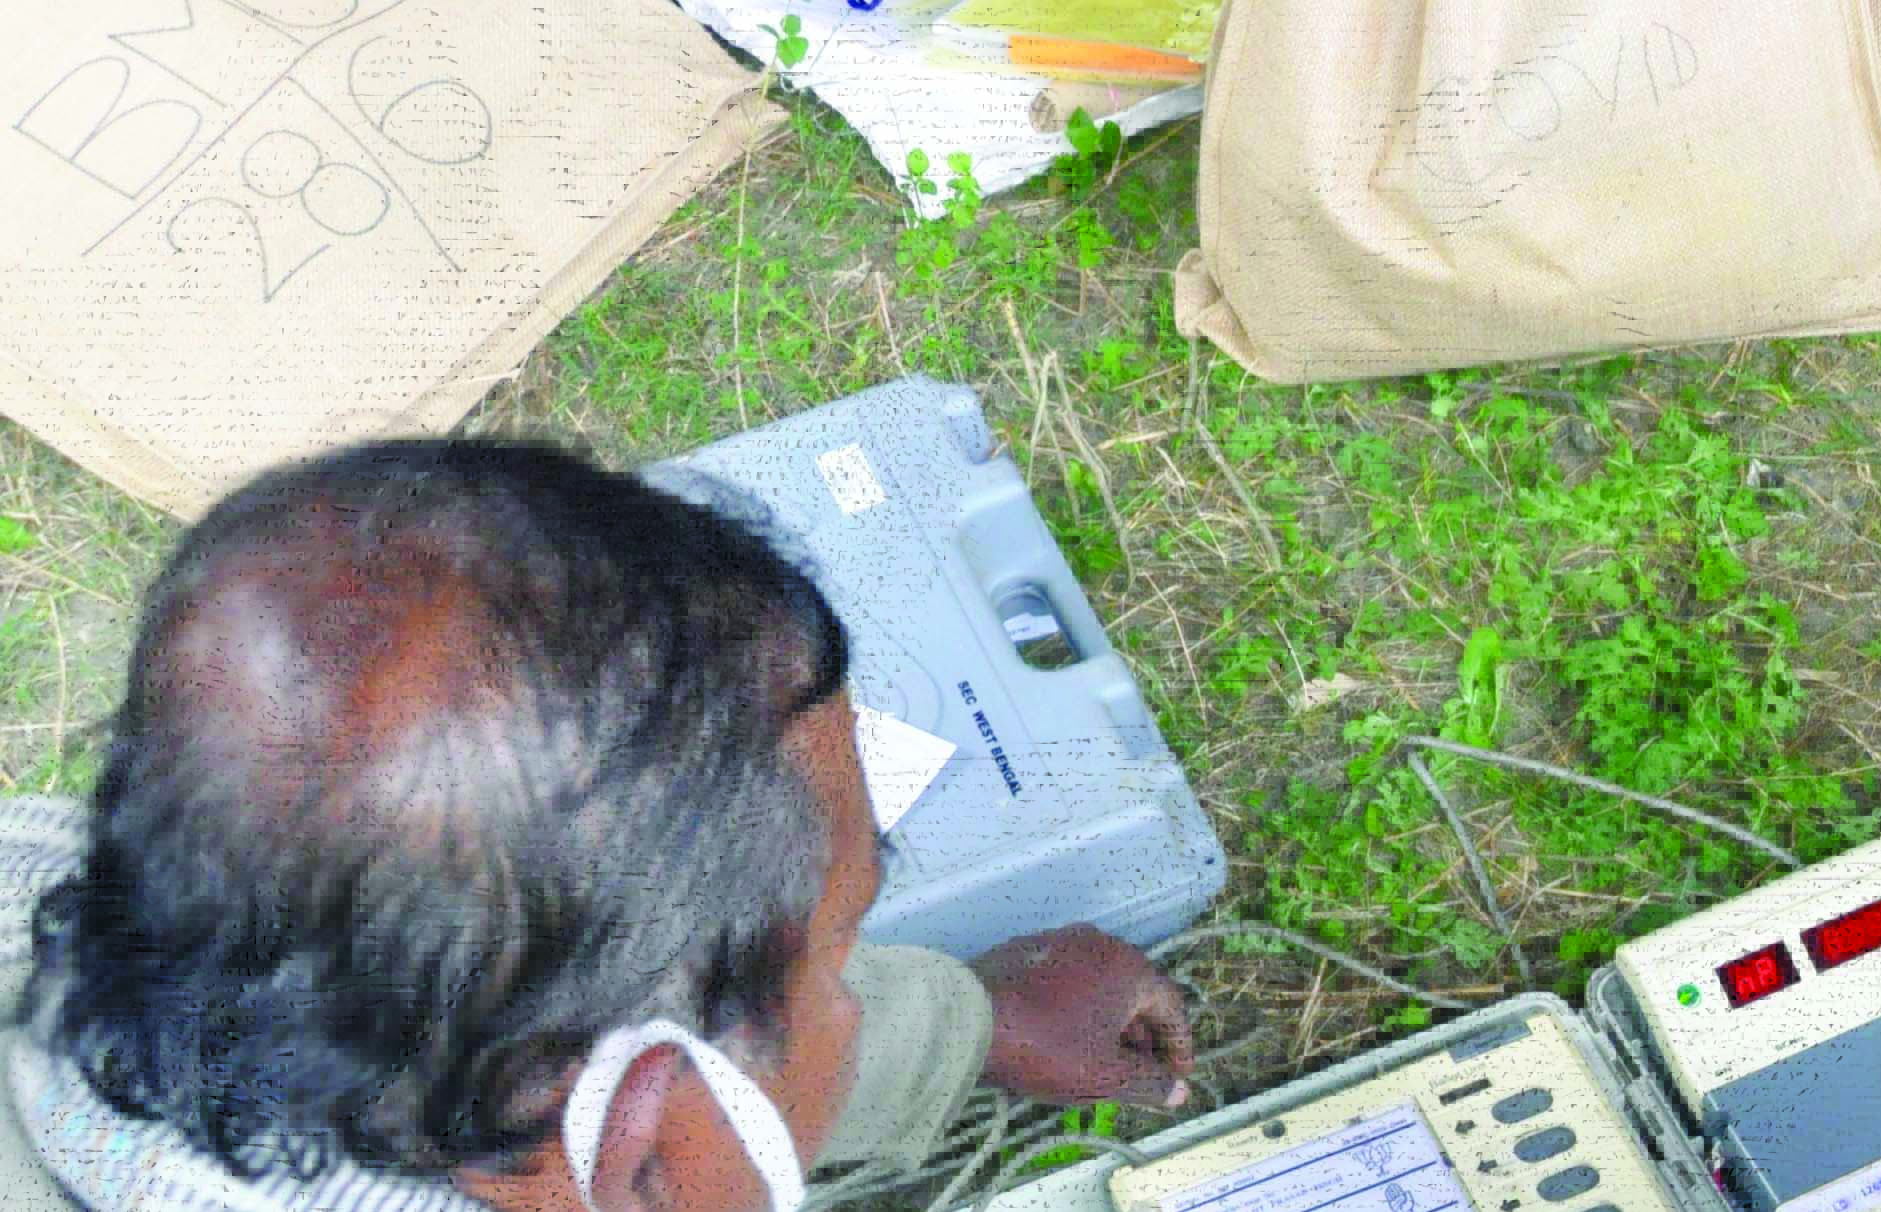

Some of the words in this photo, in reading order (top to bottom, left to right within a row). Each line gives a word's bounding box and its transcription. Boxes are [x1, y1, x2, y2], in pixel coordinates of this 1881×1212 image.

[957, 680, 978, 706] SEC
[972, 709, 998, 744] WEST
[990, 745, 1023, 799] BENGAL
